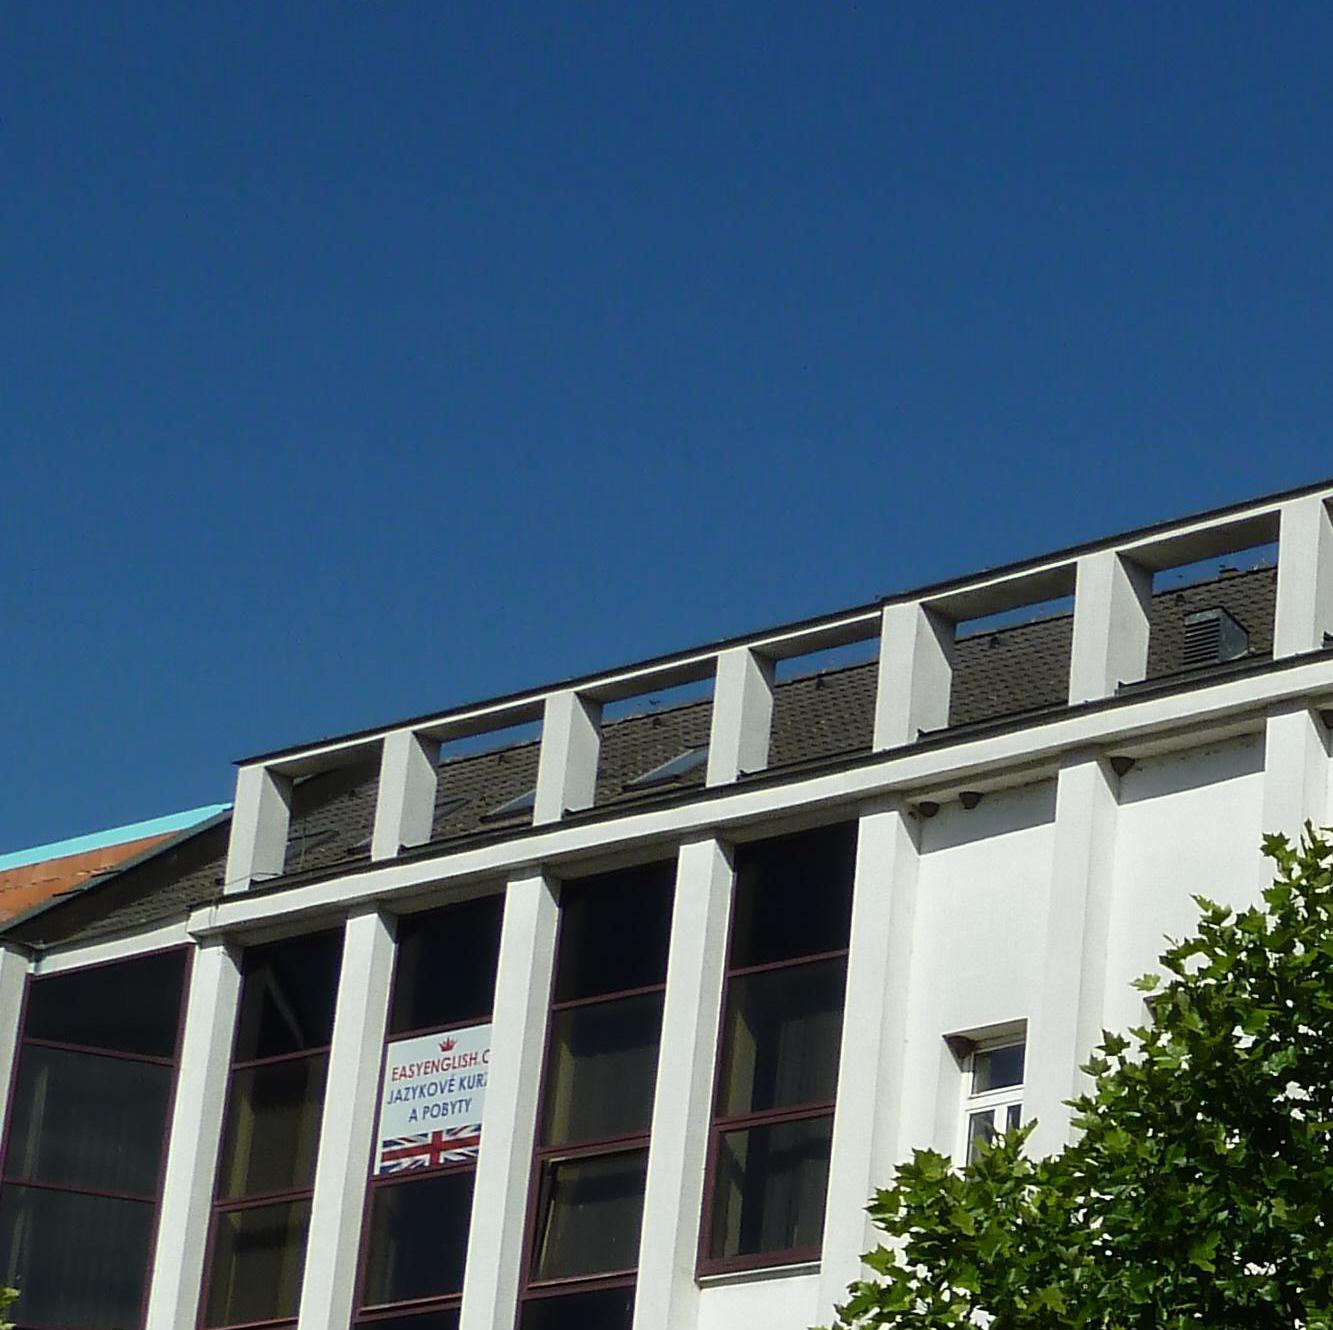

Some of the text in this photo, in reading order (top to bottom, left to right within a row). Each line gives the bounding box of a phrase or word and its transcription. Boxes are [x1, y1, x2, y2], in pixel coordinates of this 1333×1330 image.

[387, 1073, 455, 1105] JAZYKOVÉ
[408, 1097, 473, 1122] A POBYTY
